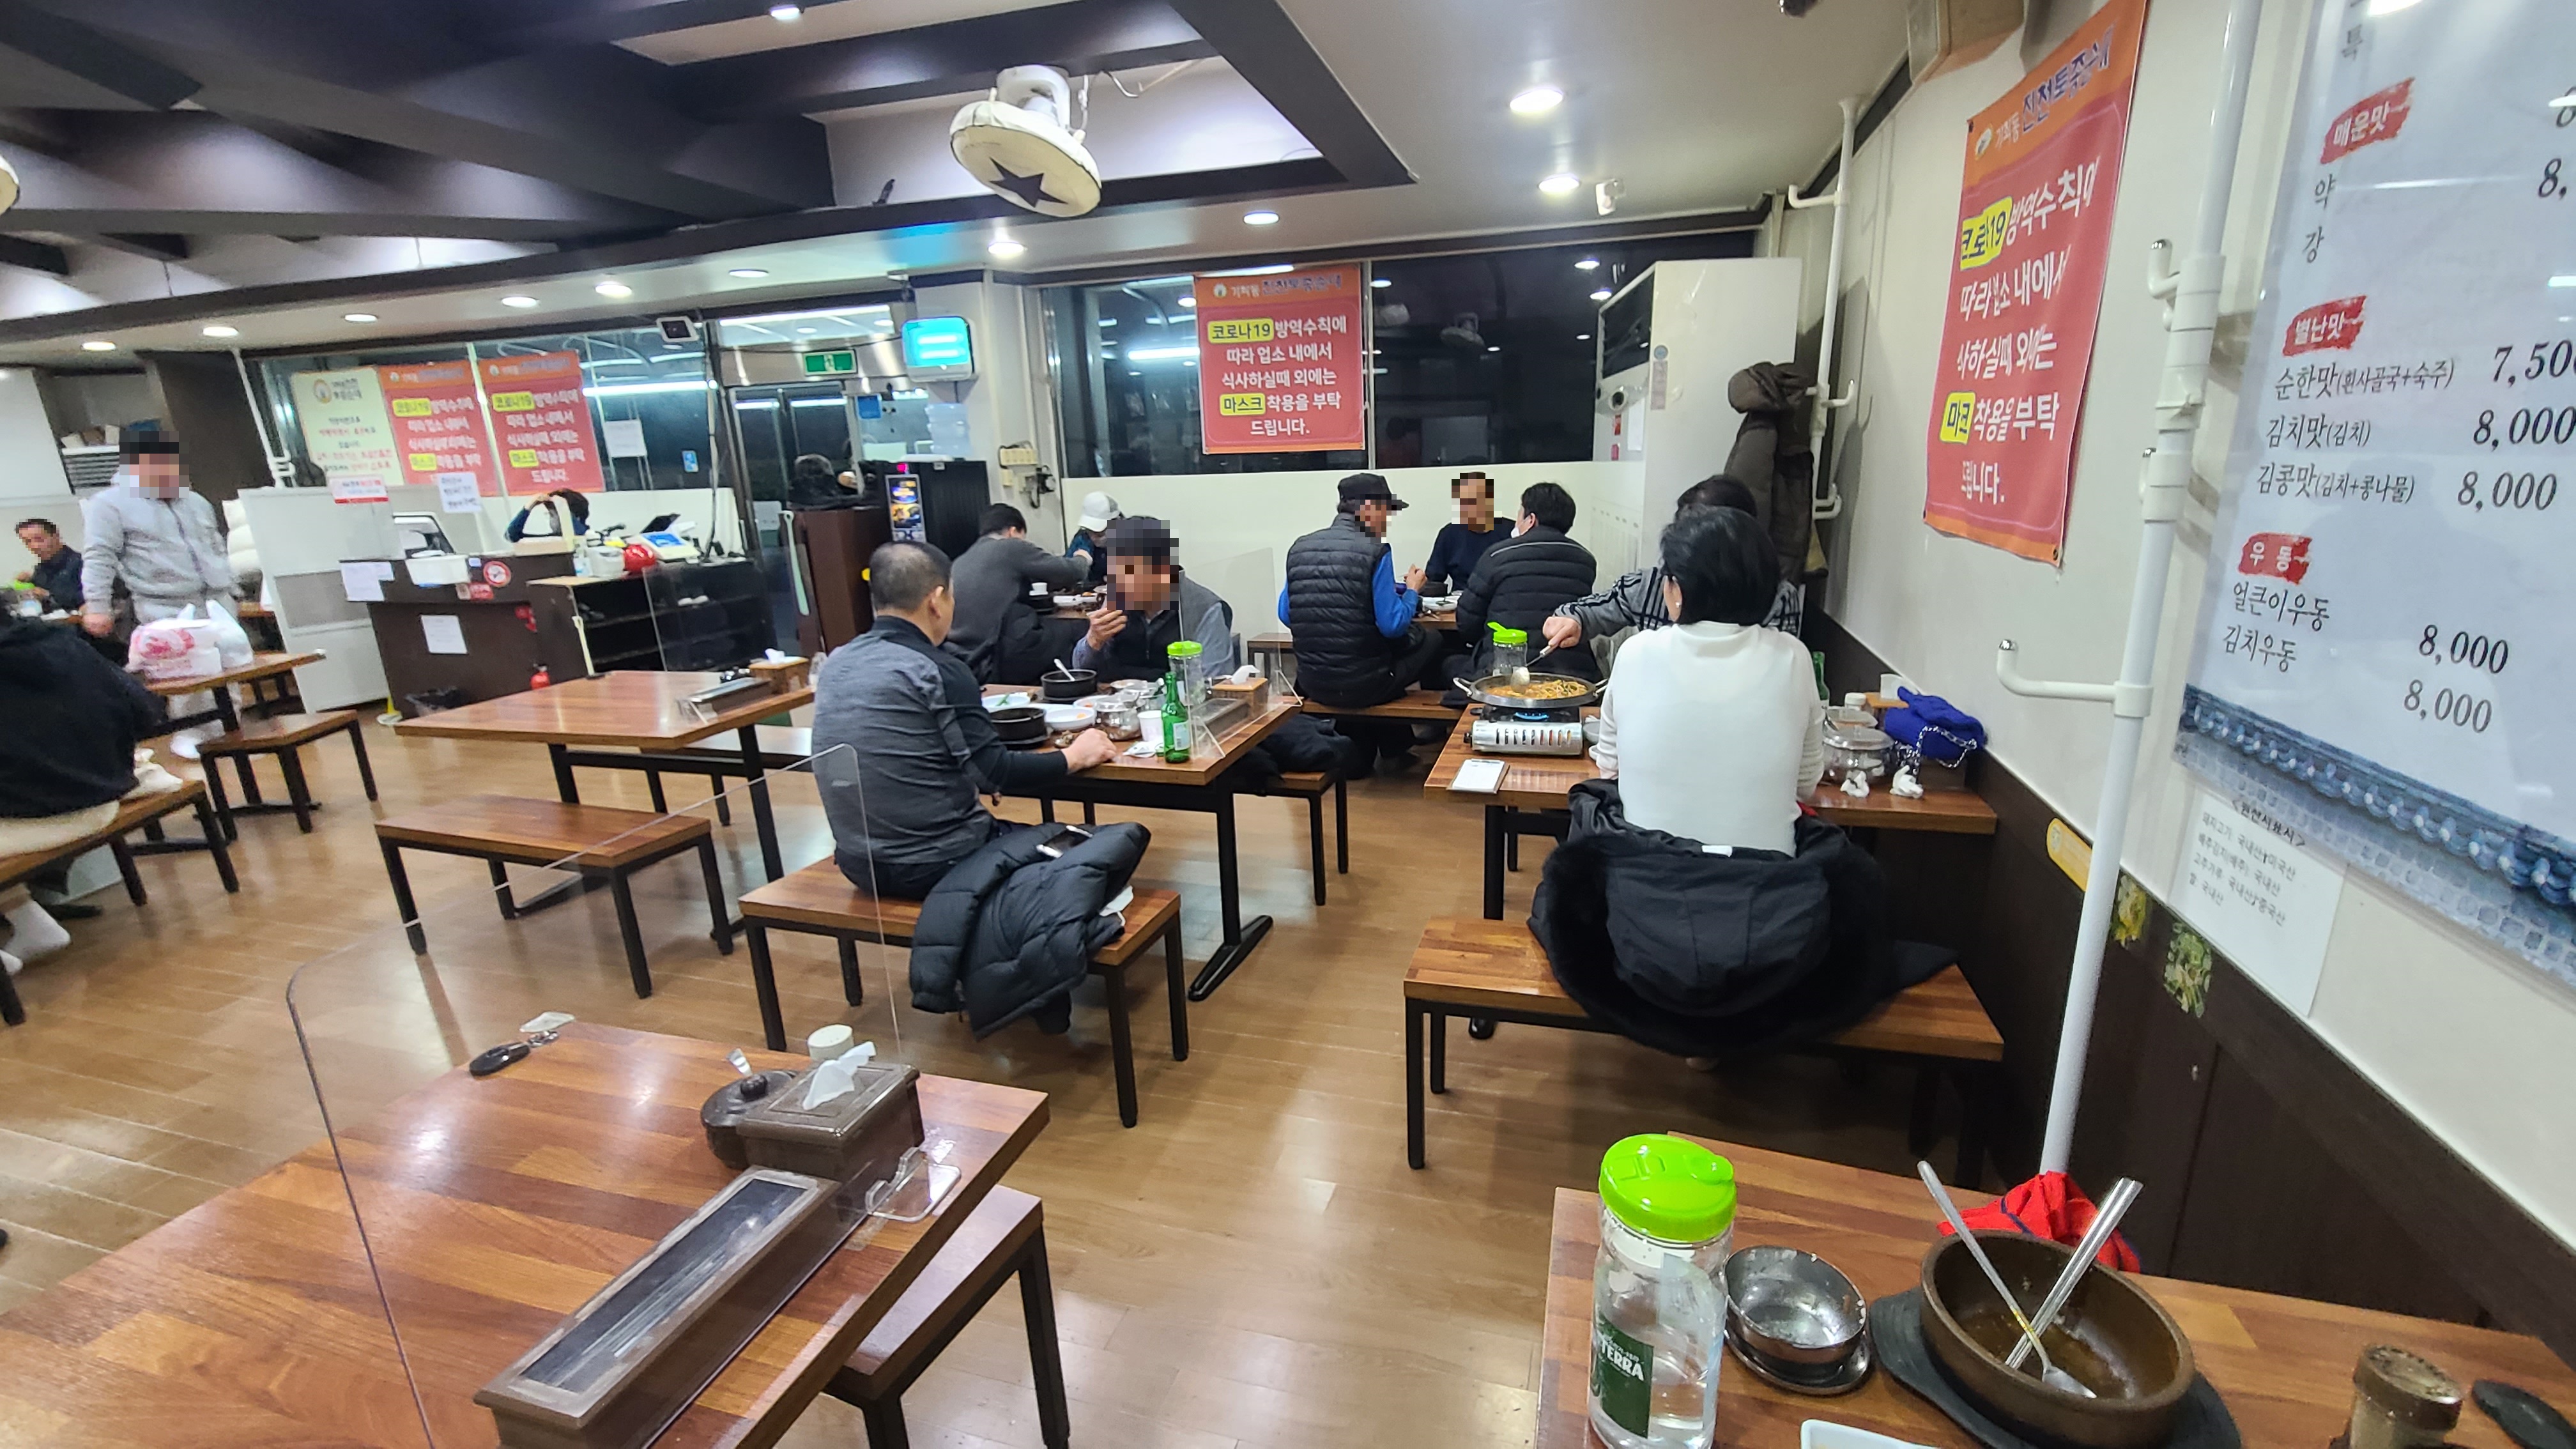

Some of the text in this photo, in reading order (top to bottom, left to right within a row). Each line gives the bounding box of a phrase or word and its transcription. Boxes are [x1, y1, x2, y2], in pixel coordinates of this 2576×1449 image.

[2333, 100, 2391, 147] 매운맛
[2315, 173, 2336, 210] 약
[2302, 226, 2324, 263] 강
[1212, 316, 1347, 339] 코로나19 방역수칙에
[2295, 311, 2345, 345] 별난맛
[1227, 341, 1333, 365] 따라 업소 내에서
[2494, 339, 2576, 388] 7,50
[1222, 368, 1337, 390] 식사하실때 외에는
[1223, 392, 1342, 413] 마스크 착용을 부탁
[2013, 391, 2060, 441] 부탁
[1250, 418, 1310, 436] 드립니다.
[2473, 406, 2576, 452] 8,000
[2458, 470, 2557, 513] 8,000
[2234, 581, 2509, 675] 얼큰이우동 8,000
[2223, 624, 2492, 733] 김치우동 8,000
[1598, 1337, 1644, 1381] TERRA
